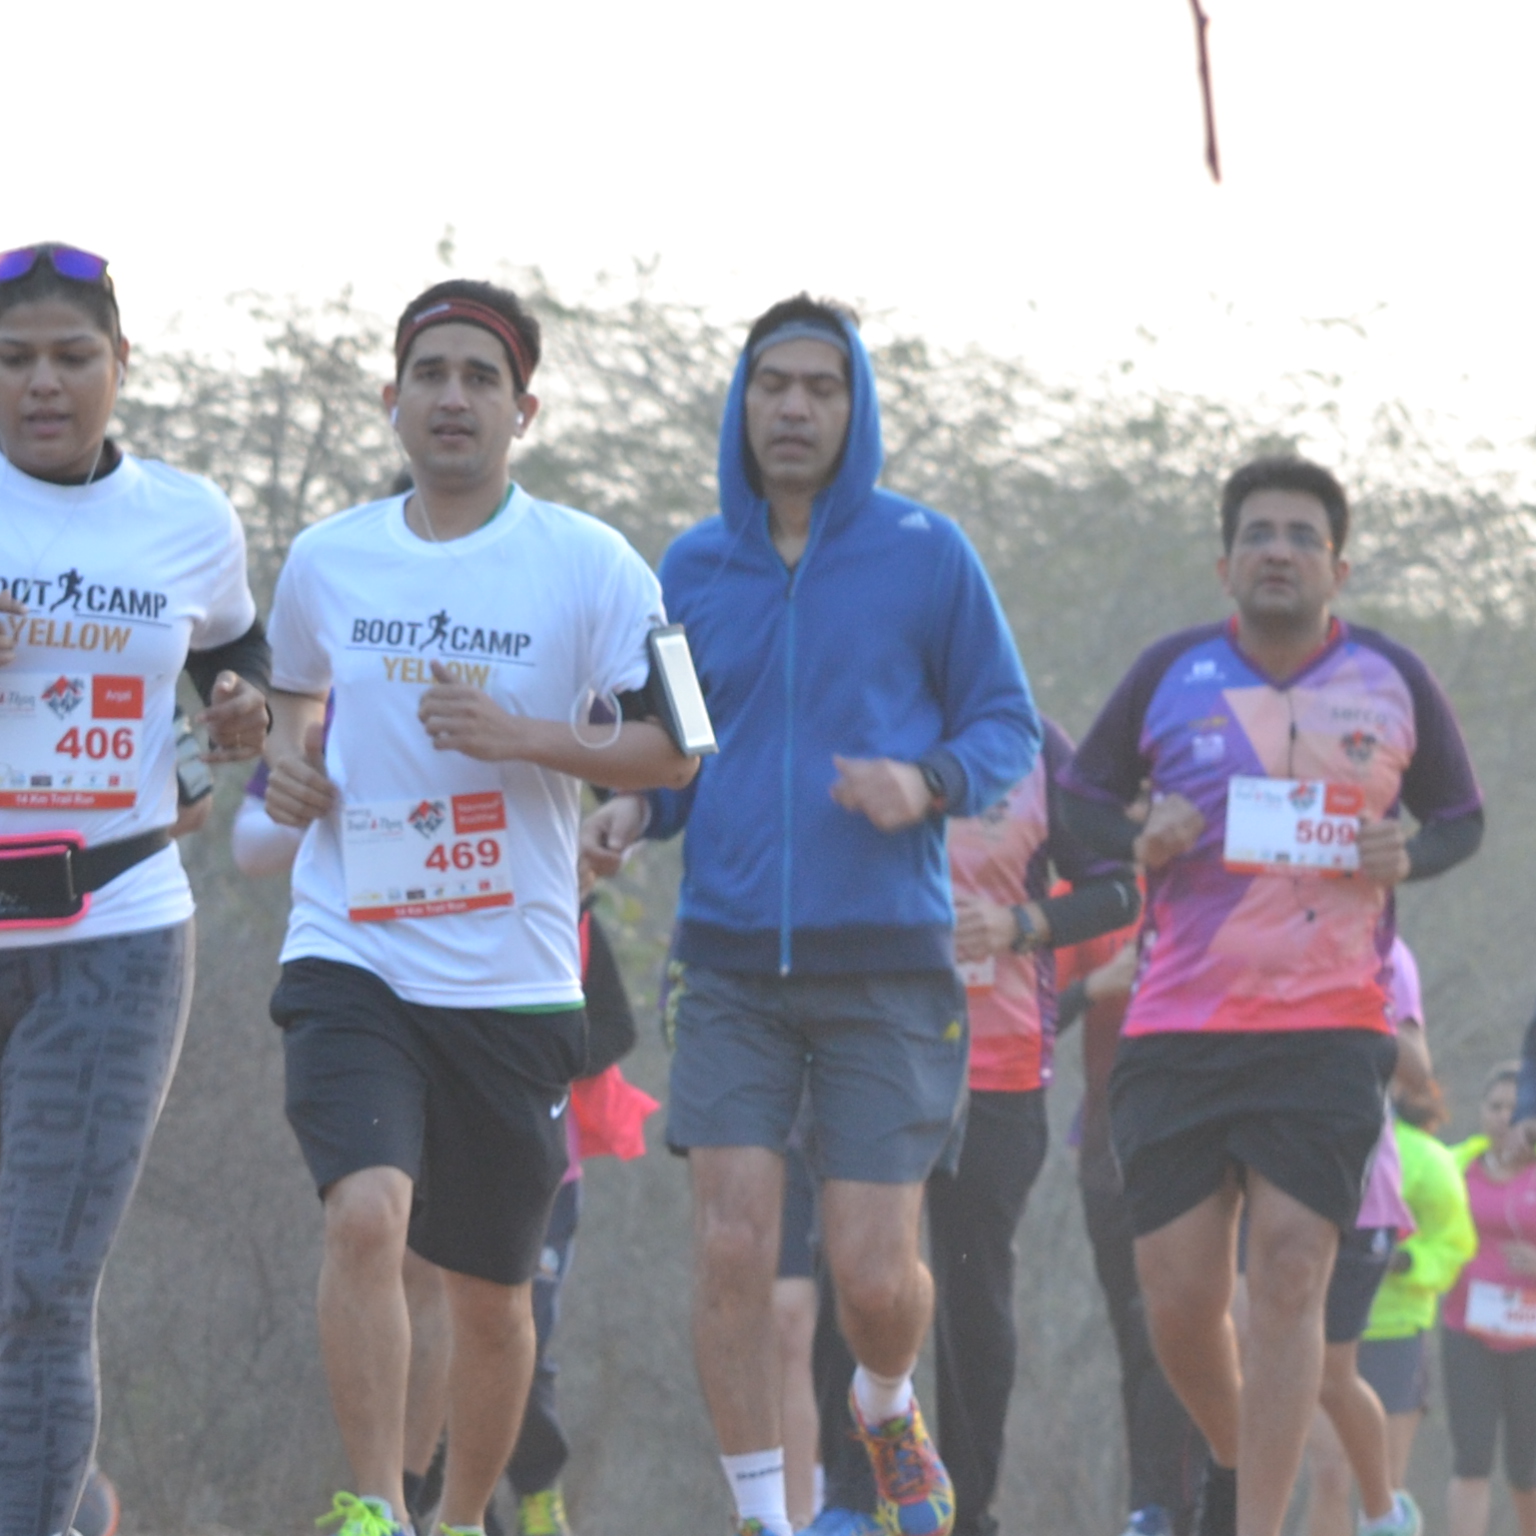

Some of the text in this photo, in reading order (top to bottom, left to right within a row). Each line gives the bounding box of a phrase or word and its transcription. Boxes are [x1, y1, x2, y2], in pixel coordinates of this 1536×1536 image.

[87, 584, 168, 618] CAMP
[8, 616, 132, 653] YELLOW
[352, 618, 531, 657] BOOT CAMP
[55, 726, 134, 760] 406
[1296, 819, 1357, 846] 509
[424, 838, 501, 872] 469
